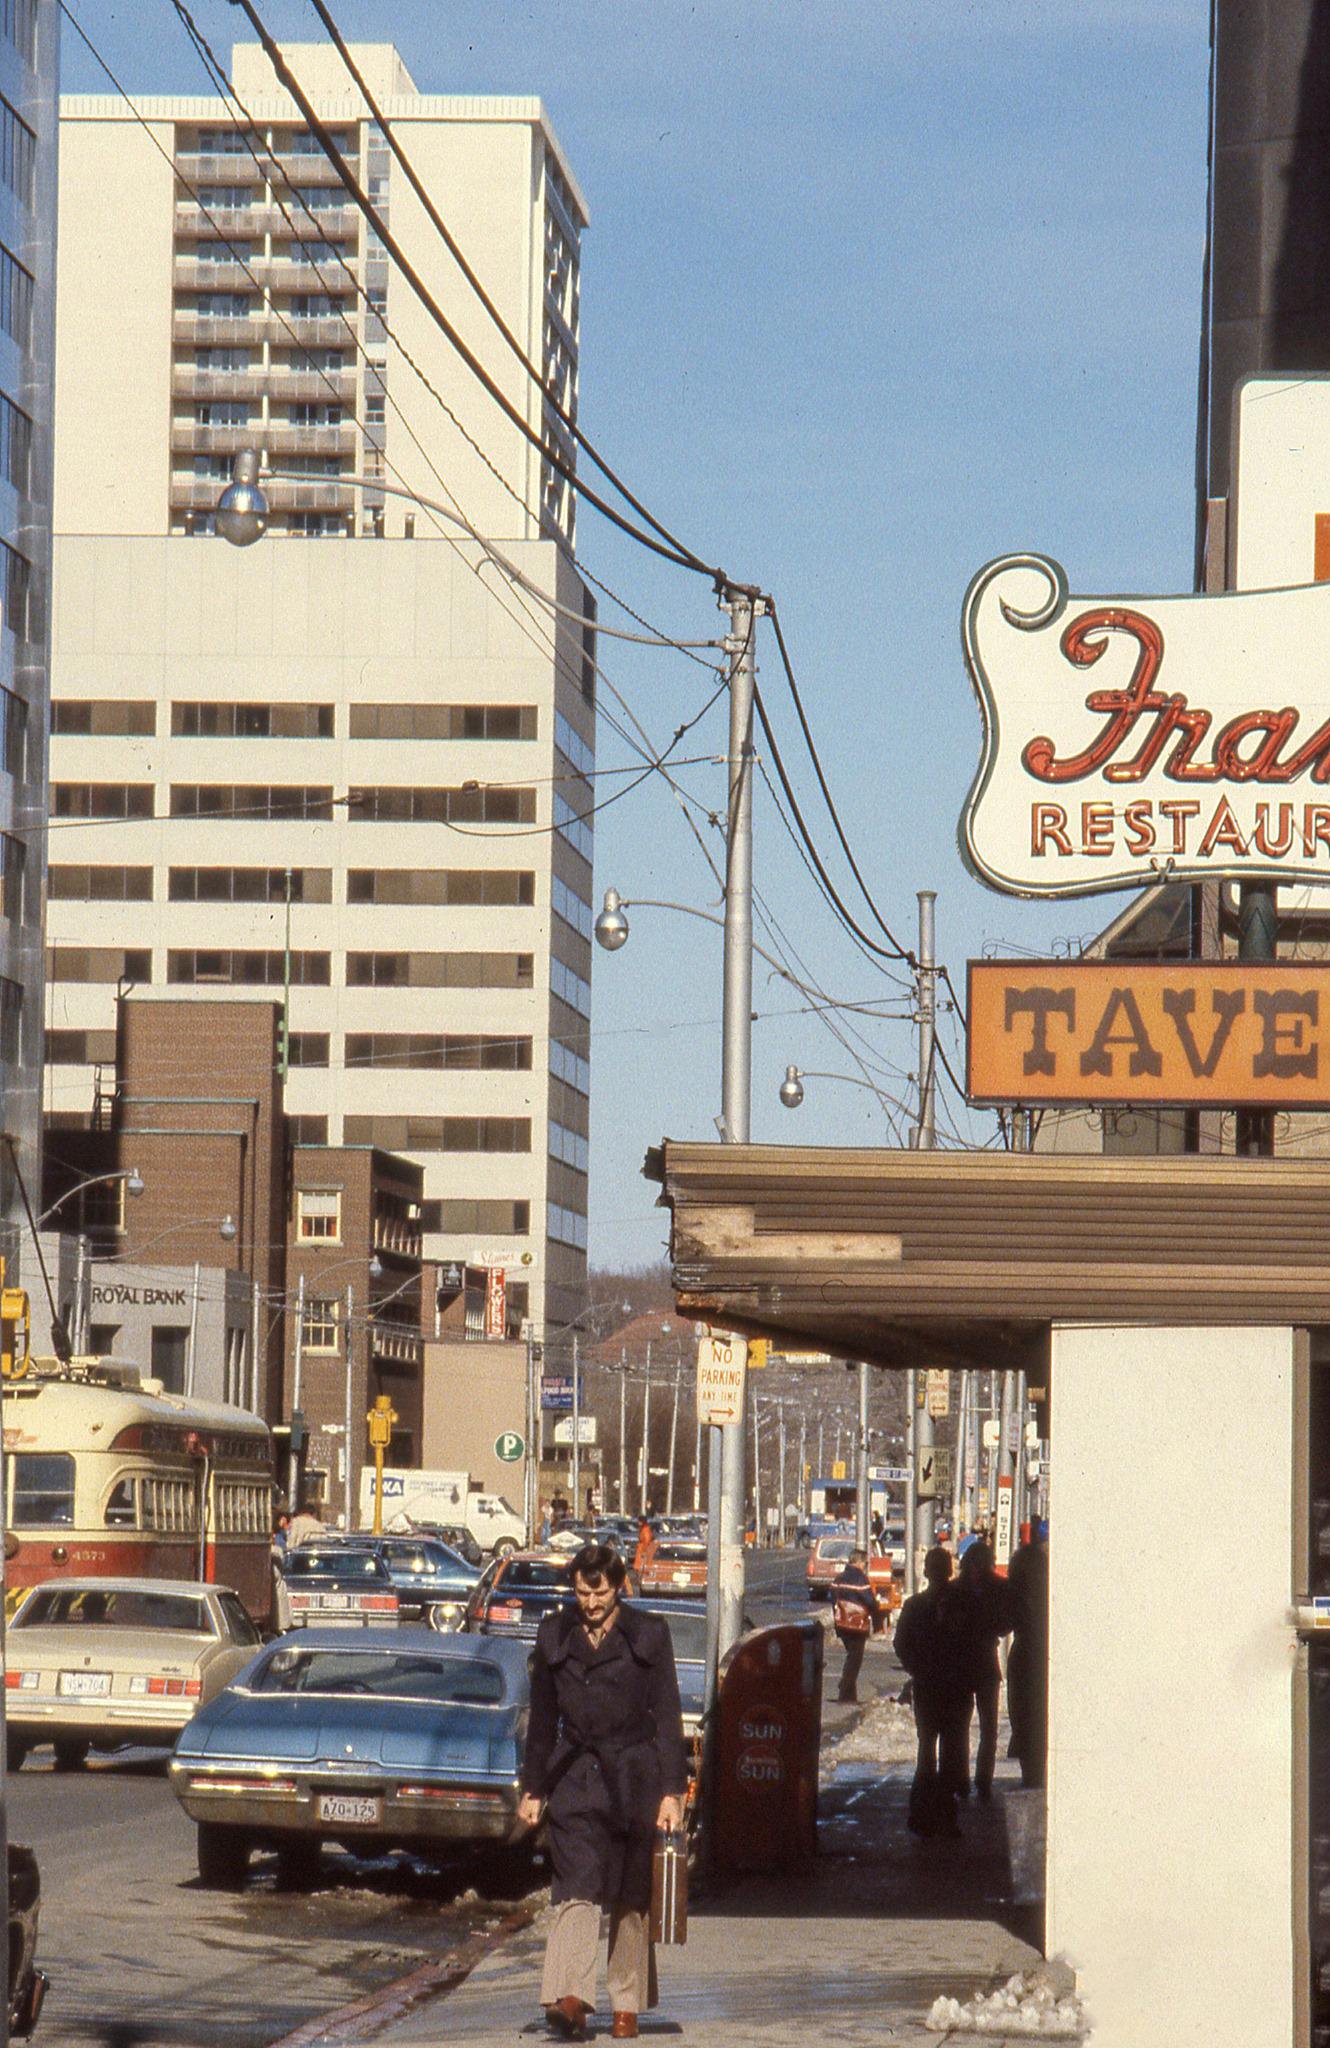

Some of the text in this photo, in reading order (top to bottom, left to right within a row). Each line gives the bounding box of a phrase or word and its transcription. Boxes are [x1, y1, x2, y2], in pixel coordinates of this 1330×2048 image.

[1004, 986, 1319, 1079] TAVE
[92, 1285, 186, 1306] ROYAL BANK
[490, 1268, 504, 1334] FLOWERS
[713, 1347, 733, 1364] NO
[701, 1368, 741, 1387] PARKING
[703, 1390, 738, 1403] ANY TIME
[504, 1435, 517, 1455] P
[1000, 1516, 1008, 1547] STOP
[743, 1723, 782, 1739] SUN
[740, 1765, 780, 1780] SUN
